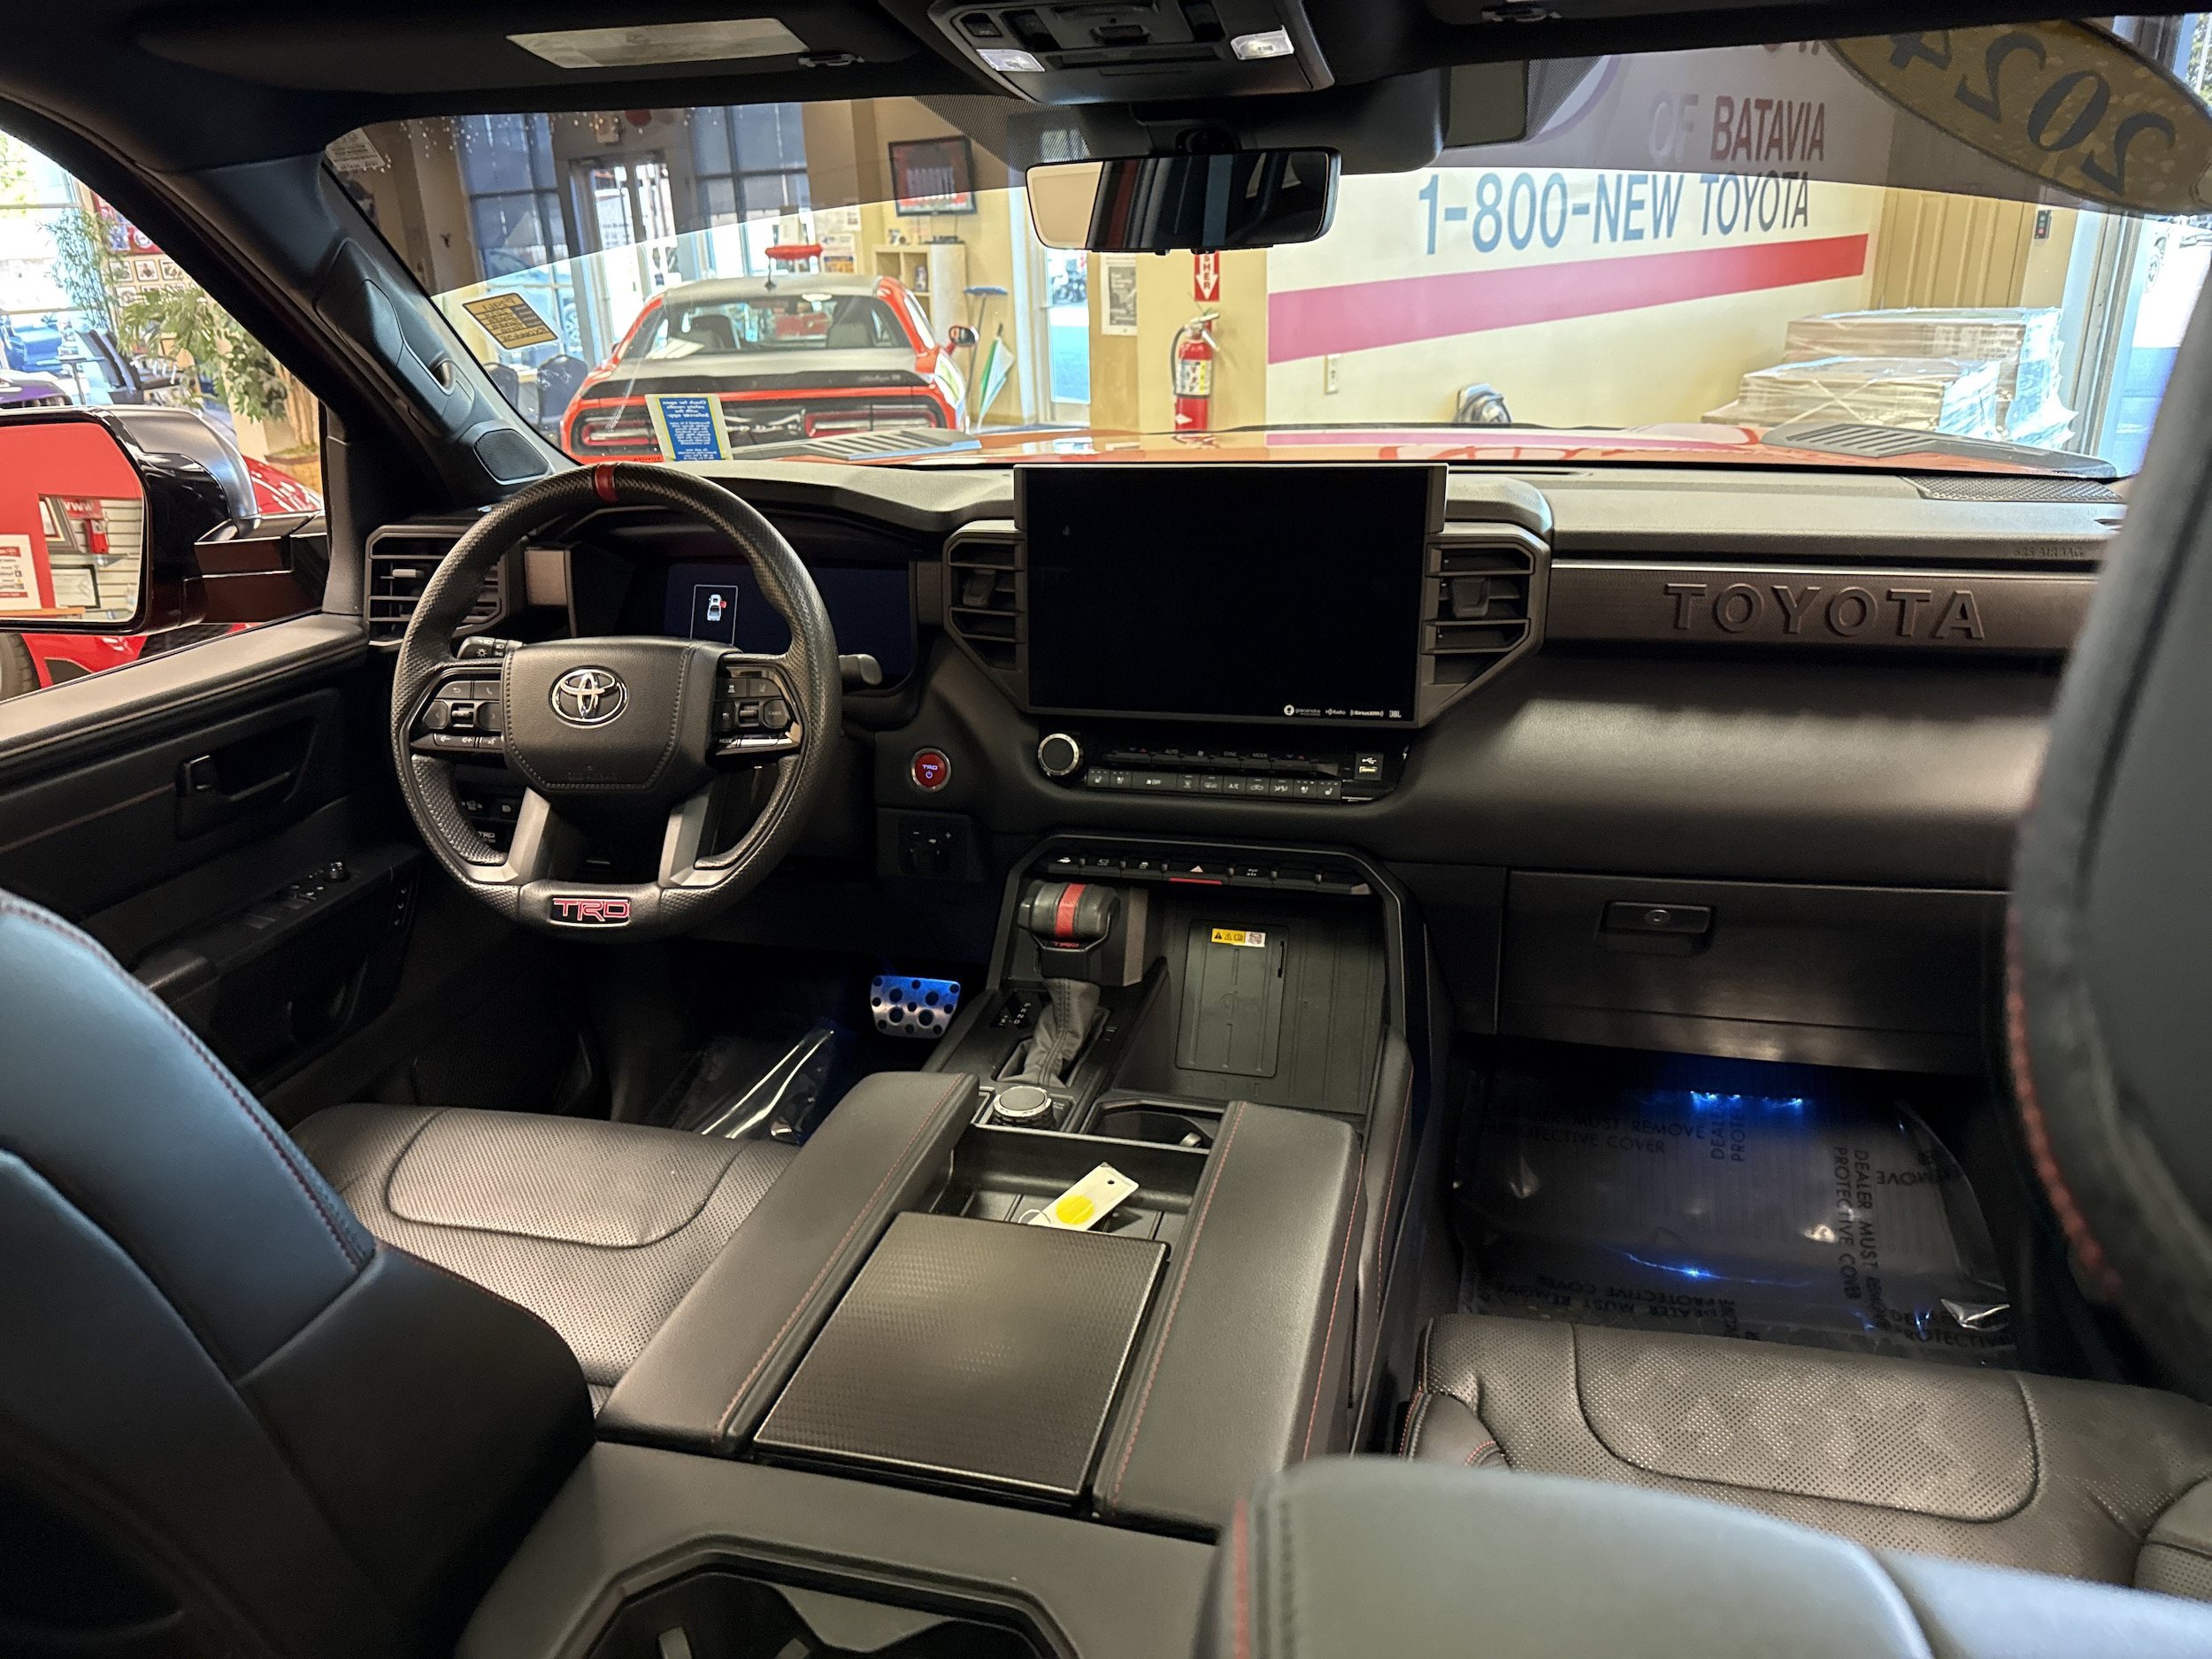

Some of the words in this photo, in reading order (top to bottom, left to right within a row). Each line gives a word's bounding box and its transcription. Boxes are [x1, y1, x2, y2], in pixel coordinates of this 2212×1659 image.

[1649, 92, 1699, 165] OF
[1710, 95, 1825, 163] BATAVIA
[1417, 172, 1685, 257] 1-800-NEW
[1699, 171, 1809, 236] TOYOTA
[1664, 582, 1985, 641] TOYOTA
[552, 897, 630, 922] TRD
[1853, 1148, 1874, 1210] DEALER
[1858, 1219, 1879, 1270] MUST
